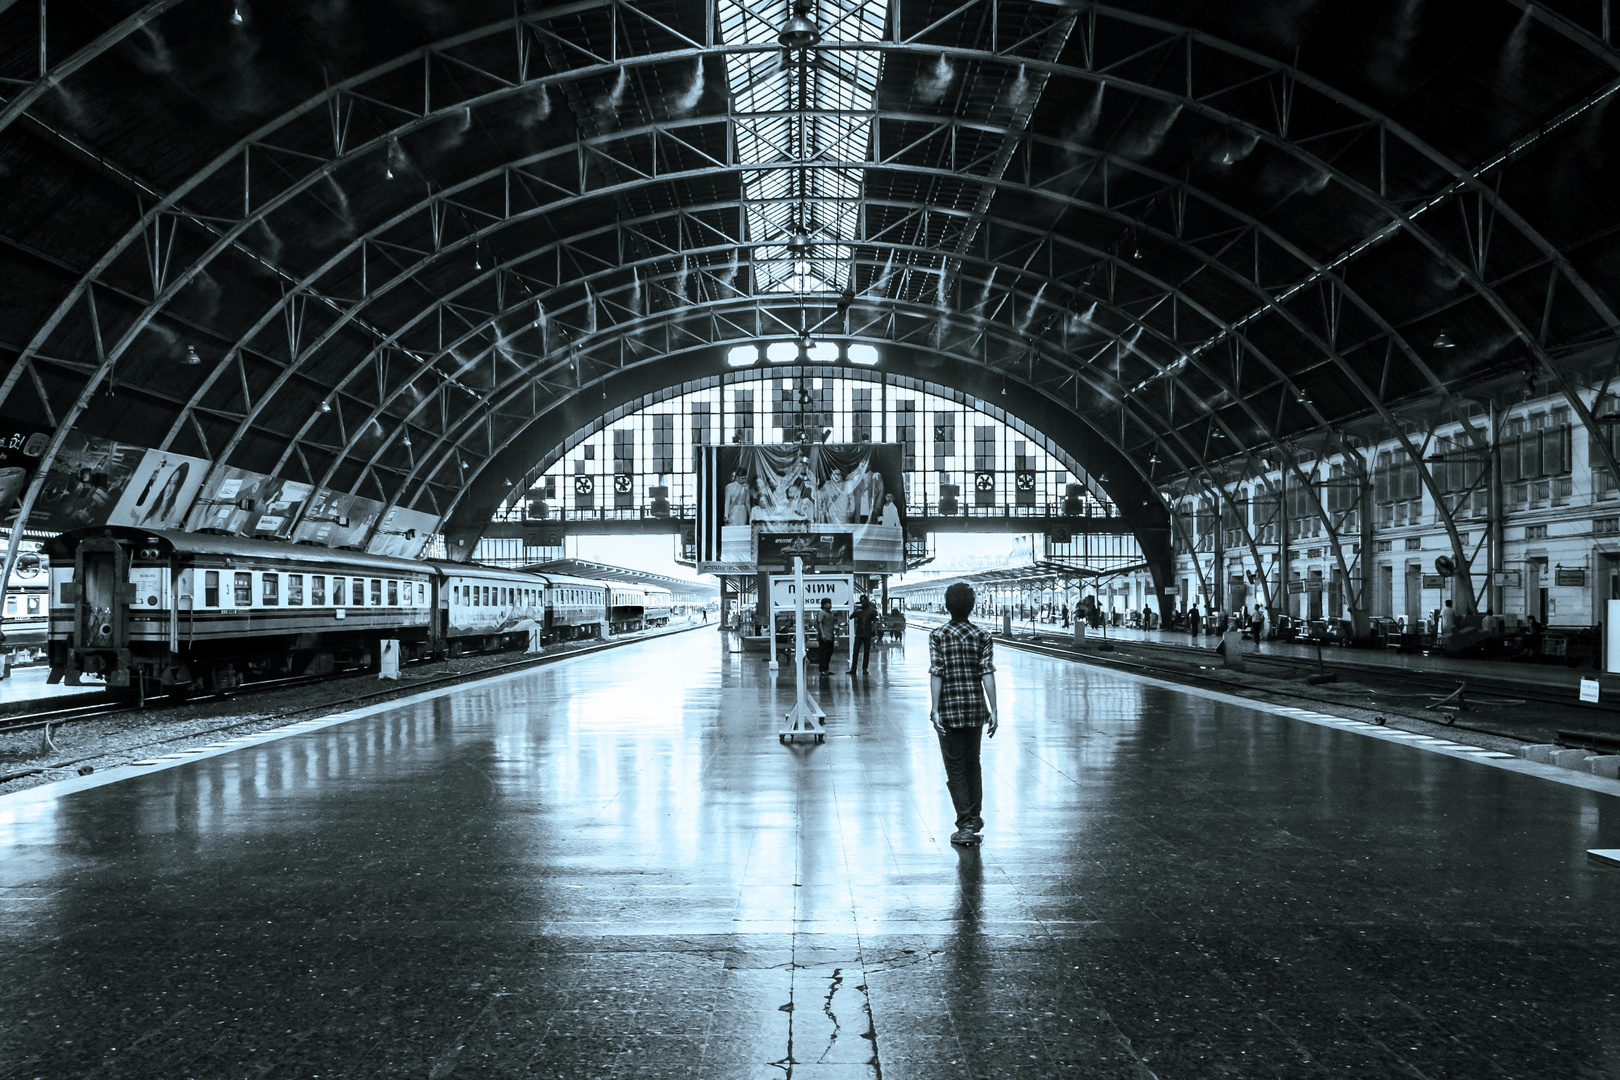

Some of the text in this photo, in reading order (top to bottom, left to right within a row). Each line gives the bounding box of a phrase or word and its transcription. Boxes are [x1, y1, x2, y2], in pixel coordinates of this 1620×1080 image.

[528, 533, 538, 546] 7
[548, 533, 558, 544] 6
[686, 530, 695, 542] 5
[1057, 529, 1067, 541] 3
[788, 584, 835, 594] กงเทพ
